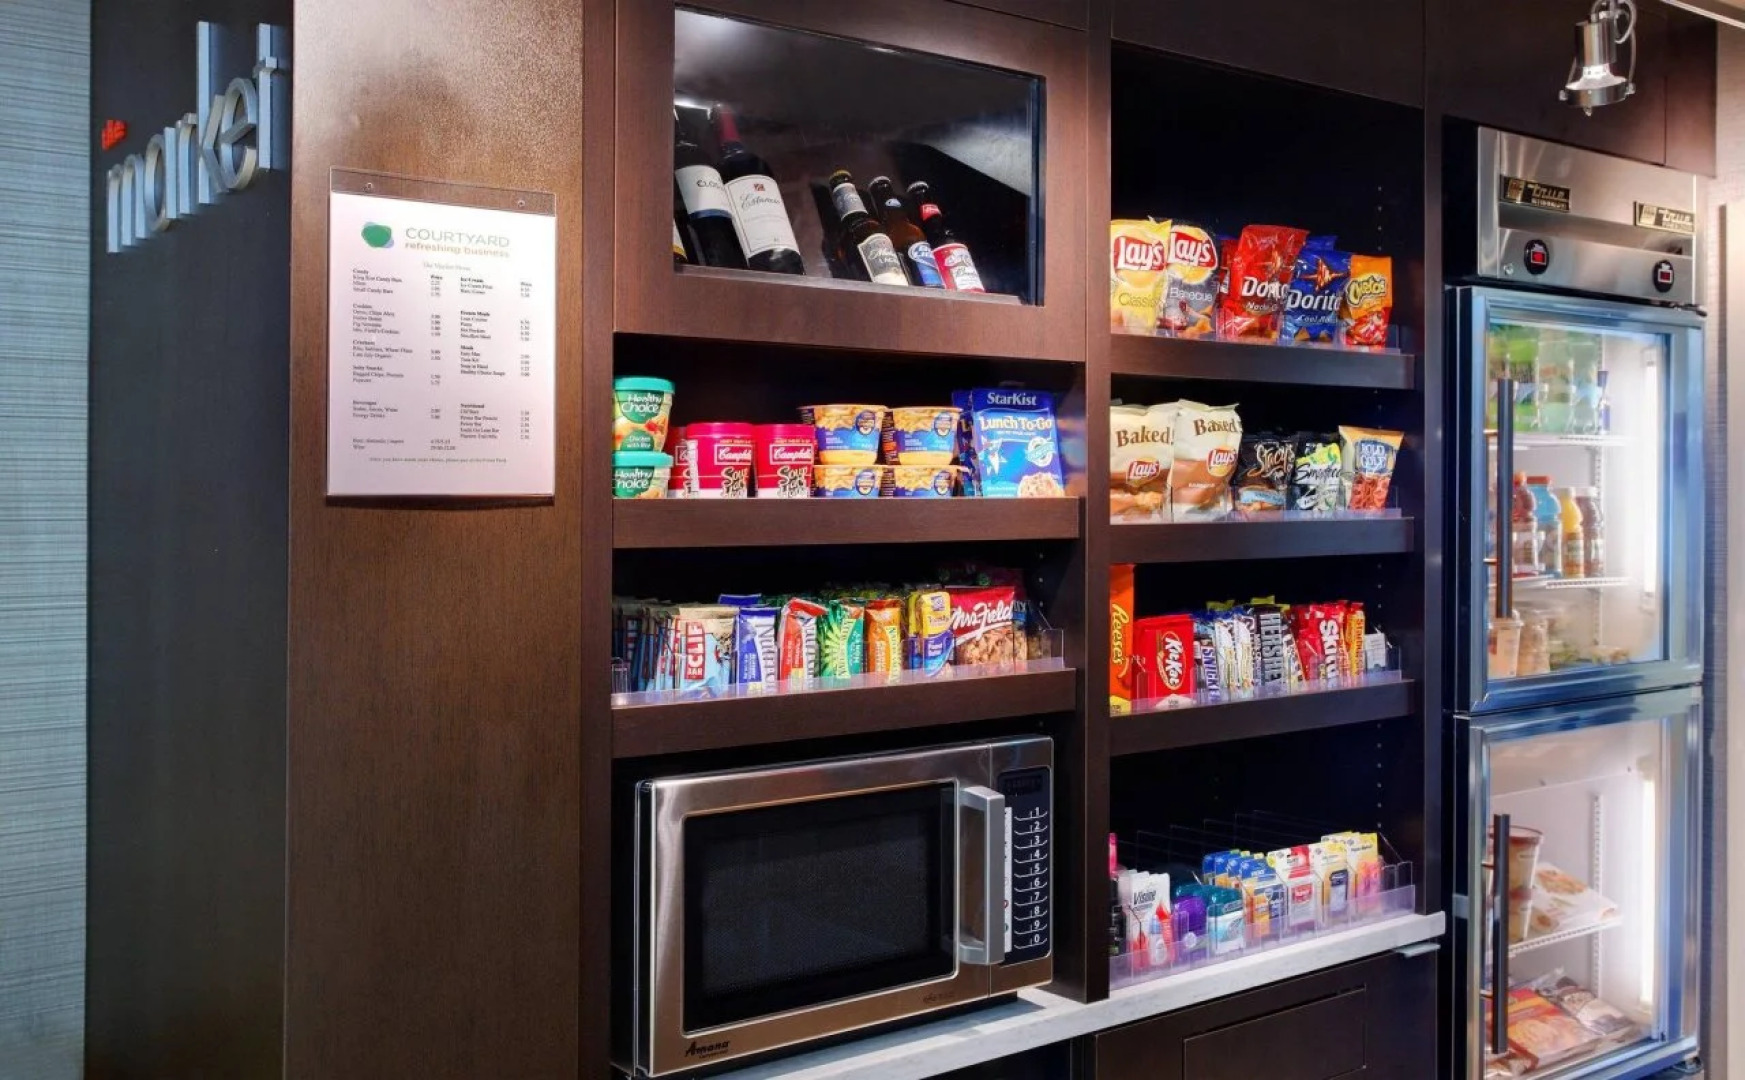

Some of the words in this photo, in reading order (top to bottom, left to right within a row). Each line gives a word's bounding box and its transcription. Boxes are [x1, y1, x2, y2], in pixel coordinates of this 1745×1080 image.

[107, 21, 277, 253] market
[405, 227, 510, 248] COURTYARD
[405, 242, 461, 255] refreshing
[464, 246, 510, 258] business
[1117, 236, 1163, 270] Lay's
[1167, 232, 1211, 266] Lay's
[628, 393, 662, 402] Healthy
[986, 392, 1037, 406] StarKist
[621, 401, 659, 413] Choice
[979, 415, 1018, 431] Lunch
[1209, 448, 1237, 466] Lay's
[1128, 461, 1160, 479] Lay's
[617, 478, 649, 489] hoice
[687, 624, 703, 667] CLIF
[1260, 613, 1284, 682] HERSHE
[1034, 807, 1040, 818] 1
[1034, 821, 1040, 830] 2
[1034, 836, 1040, 844] 3
[1034, 850, 1040, 858] 4
[1034, 863, 1040, 872] 5
[1034, 878, 1040, 886] 6
[1034, 892, 1040, 901] 7
[1034, 906, 1040, 914] 8
[1034, 920, 1040, 929] 9
[1034, 934, 1040, 943] 0
[685, 1040, 729, 1058] Amana
